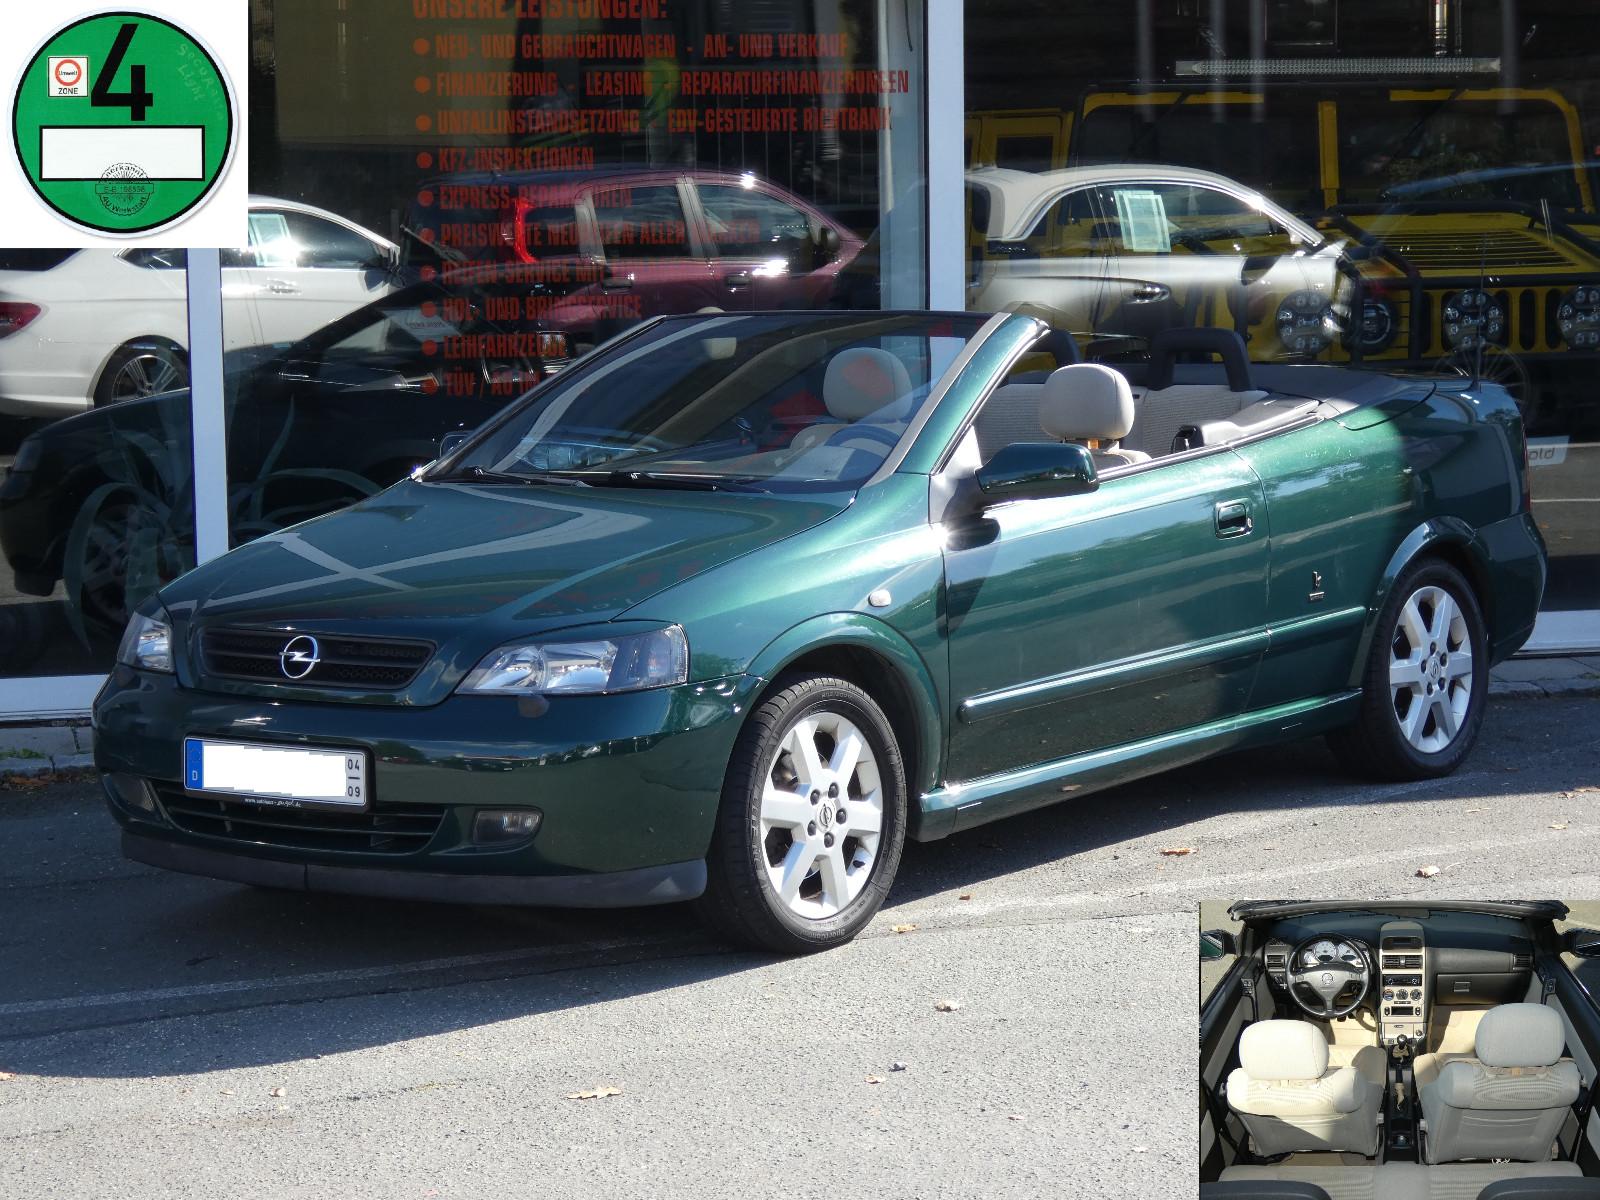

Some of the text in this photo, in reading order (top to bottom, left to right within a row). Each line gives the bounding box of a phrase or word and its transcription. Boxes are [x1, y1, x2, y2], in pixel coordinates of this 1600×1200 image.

[435, 34, 477, 59] NEU-
[481, 34, 516, 59] UND
[521, 33, 676, 59] GEBRAUCHTWAGEN
[739, 32, 774, 59] UND
[778, 32, 849, 58] VERKAUF
[436, 71, 558, 97] FINANZIERUNG
[681, 70, 909, 96] REPARATURFINANZIERUNGEN
[437, 109, 640, 135] UNFALLINSTANDSETZUNG
[668, 108, 798, 133] EDV-GESTEUERTE
[803, 107, 893, 132] RICHTBANK
[440, 222, 544, 248] PREISWTE
[485, 295, 520, 321] UND
[347, 758, 360, 771] 04
[347, 786, 361, 798] 09
